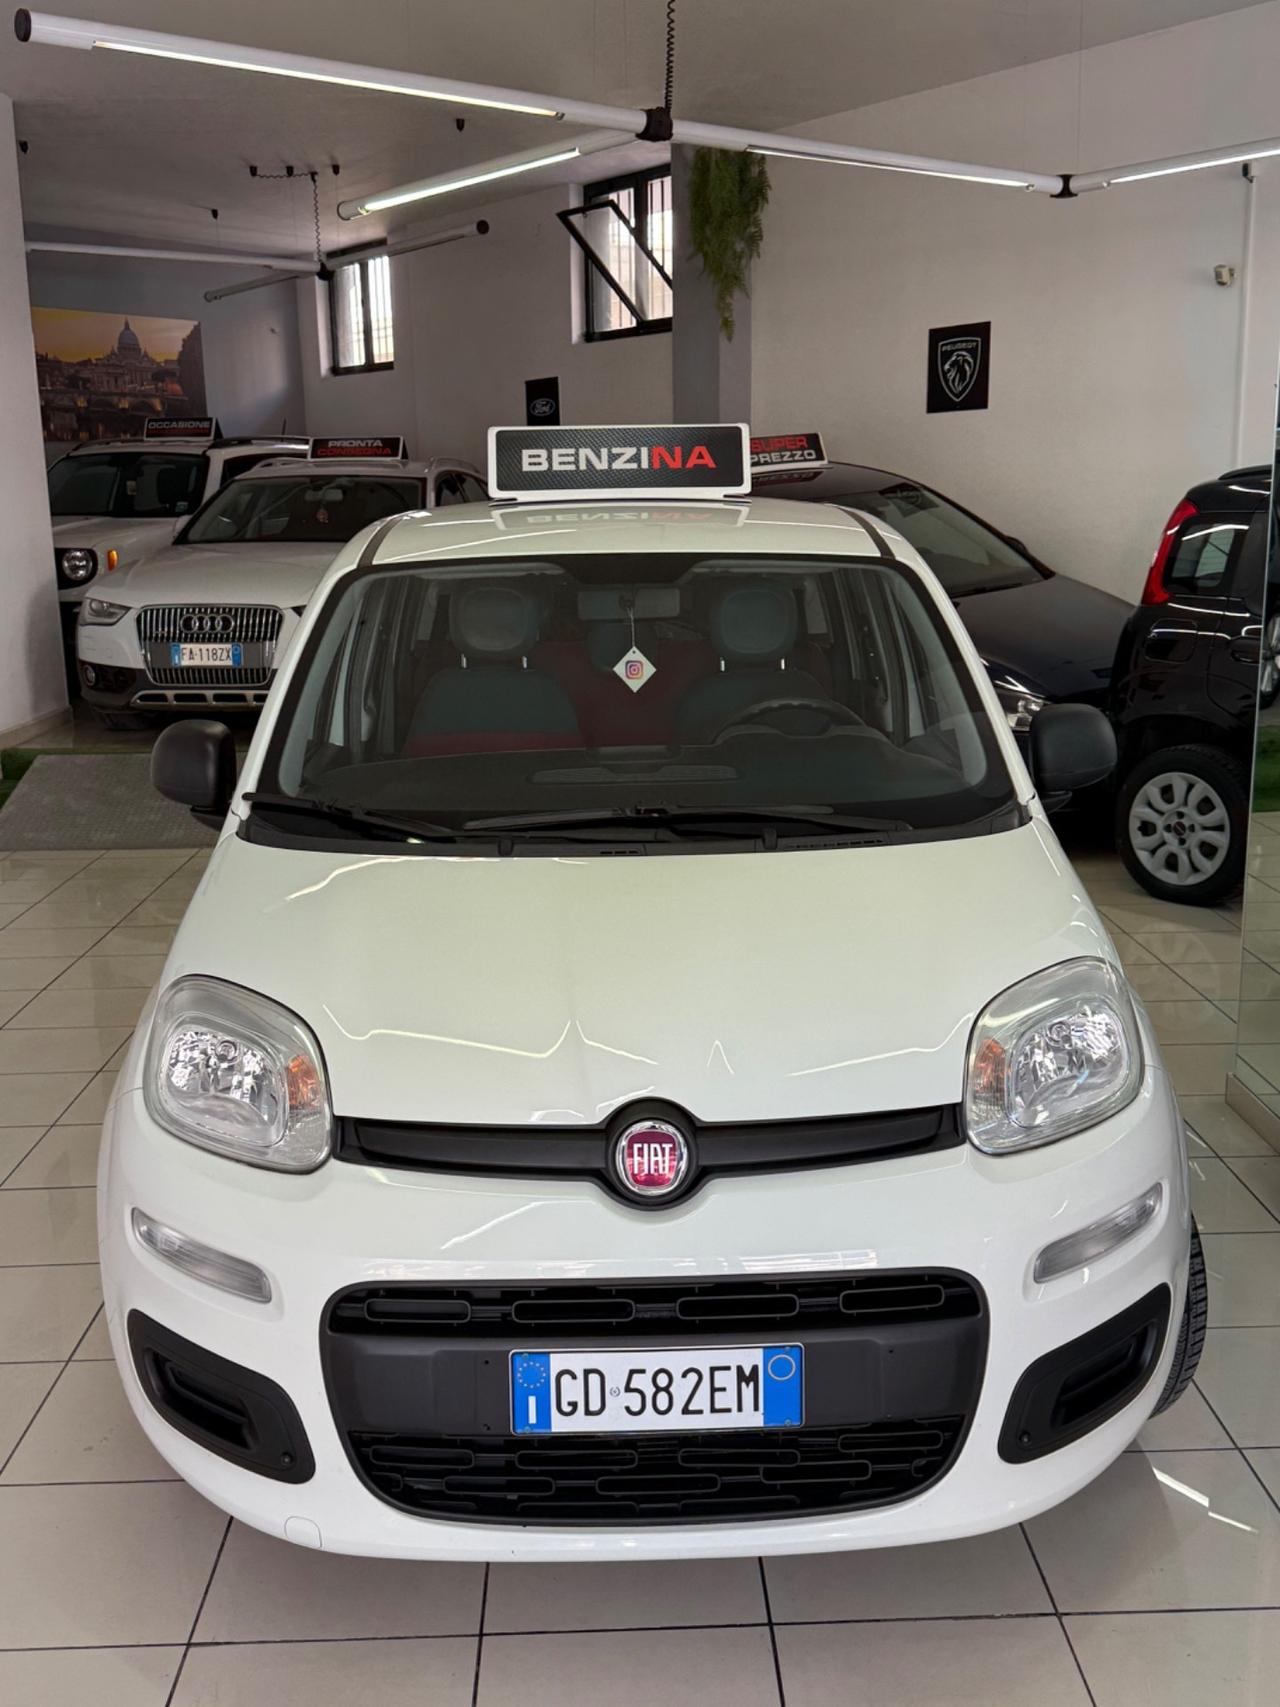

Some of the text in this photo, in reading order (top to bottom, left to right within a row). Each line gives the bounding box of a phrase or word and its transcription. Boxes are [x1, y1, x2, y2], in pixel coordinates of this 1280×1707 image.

[148, 421, 211, 429] OCCASIONE
[751, 436, 808, 452] SUPER
[521, 445, 716, 471] BENZINA
[750, 450, 816, 463] PREZZO
[633, 1143, 673, 1175] FIAT
[528, 1396, 537, 1424] I
